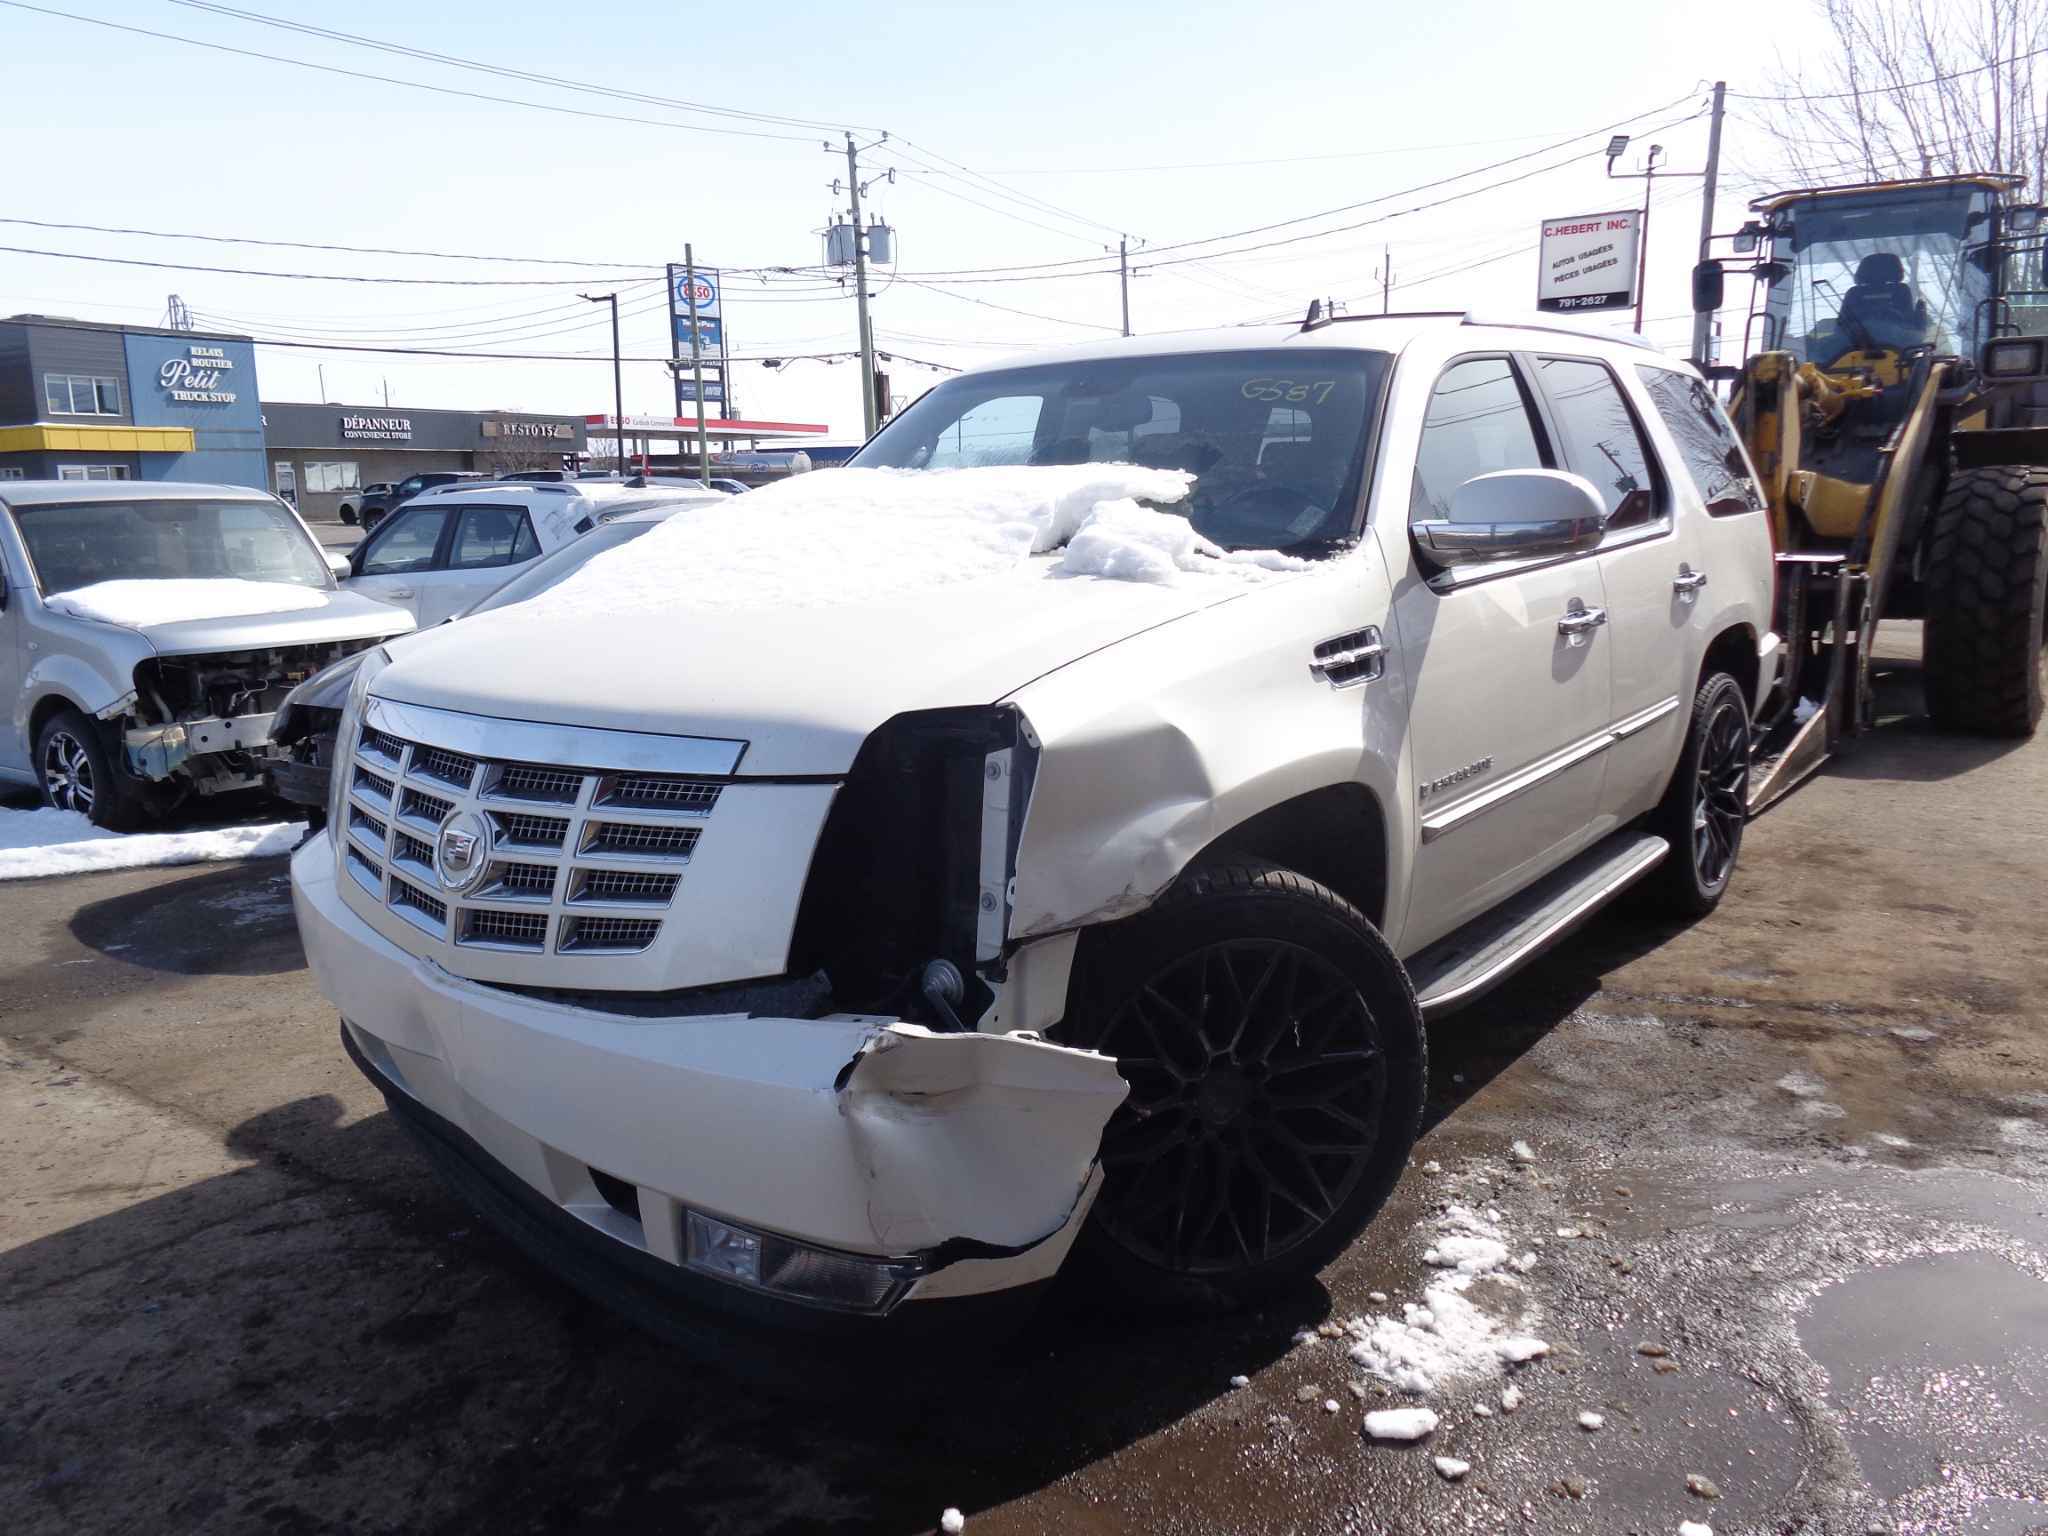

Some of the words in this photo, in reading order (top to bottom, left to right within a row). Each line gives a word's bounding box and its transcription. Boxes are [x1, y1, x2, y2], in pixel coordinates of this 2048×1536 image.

[1607, 219, 1632, 230] INC.
[1552, 256, 1575, 269] AUTOS
[684, 283, 710, 298] ESO
[191, 346, 224, 357] RELAIS
[191, 358, 234, 368] ROUTIER
[161, 359, 221, 389] Petit
[172, 391, 210, 402] TRUCK
[210, 392, 237, 403] STOP
[343, 415, 411, 430] DÉPANNEUR
[610, 416, 631, 425] ESO
[344, 430, 391, 439] CONVENIENCE
[391, 432, 412, 440] STORE
[504, 423, 539, 436] RESTO
